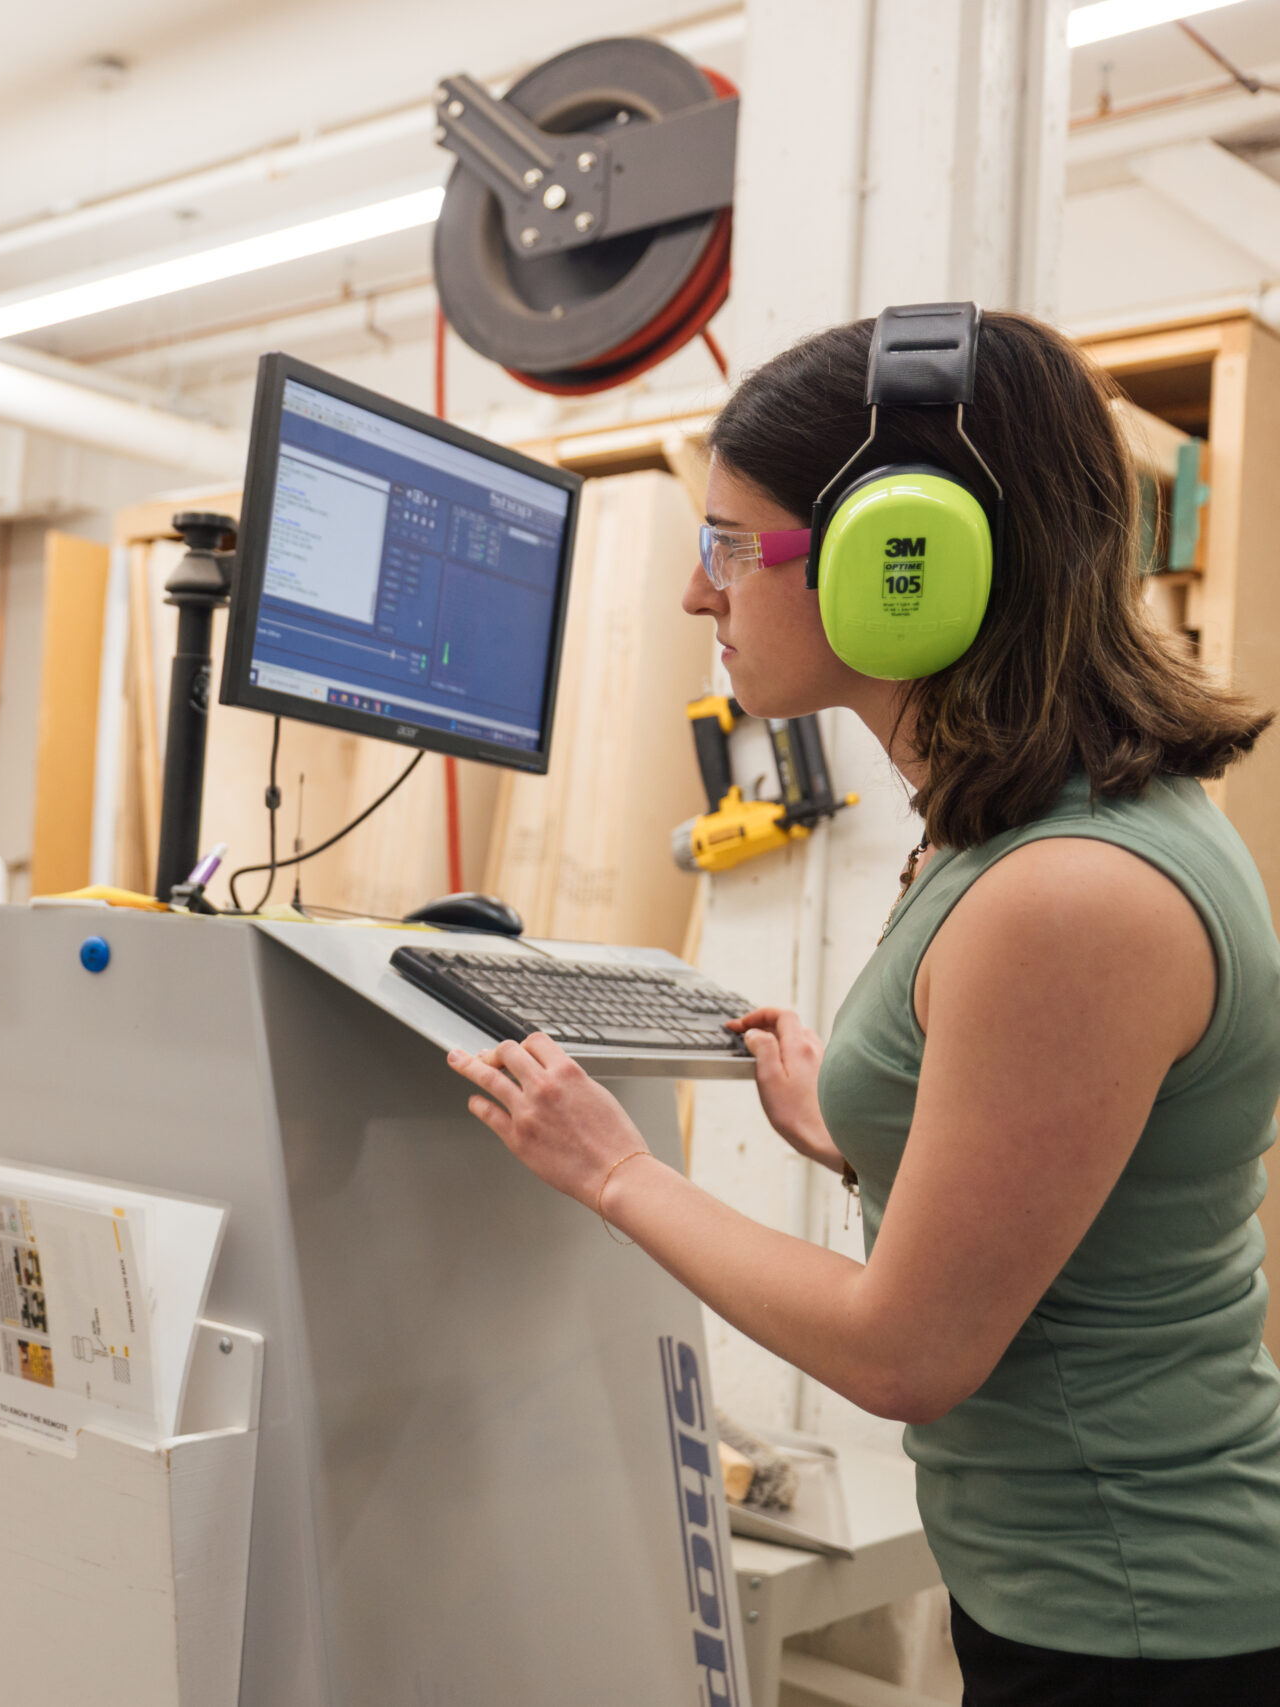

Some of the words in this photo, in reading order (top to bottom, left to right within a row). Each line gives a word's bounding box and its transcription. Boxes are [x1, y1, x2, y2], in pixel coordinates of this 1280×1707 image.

[884, 536, 926, 558] 3M
[885, 562, 923, 571] OPTIME
[885, 575, 922, 594] 105
[396, 725, 418, 738] acer
